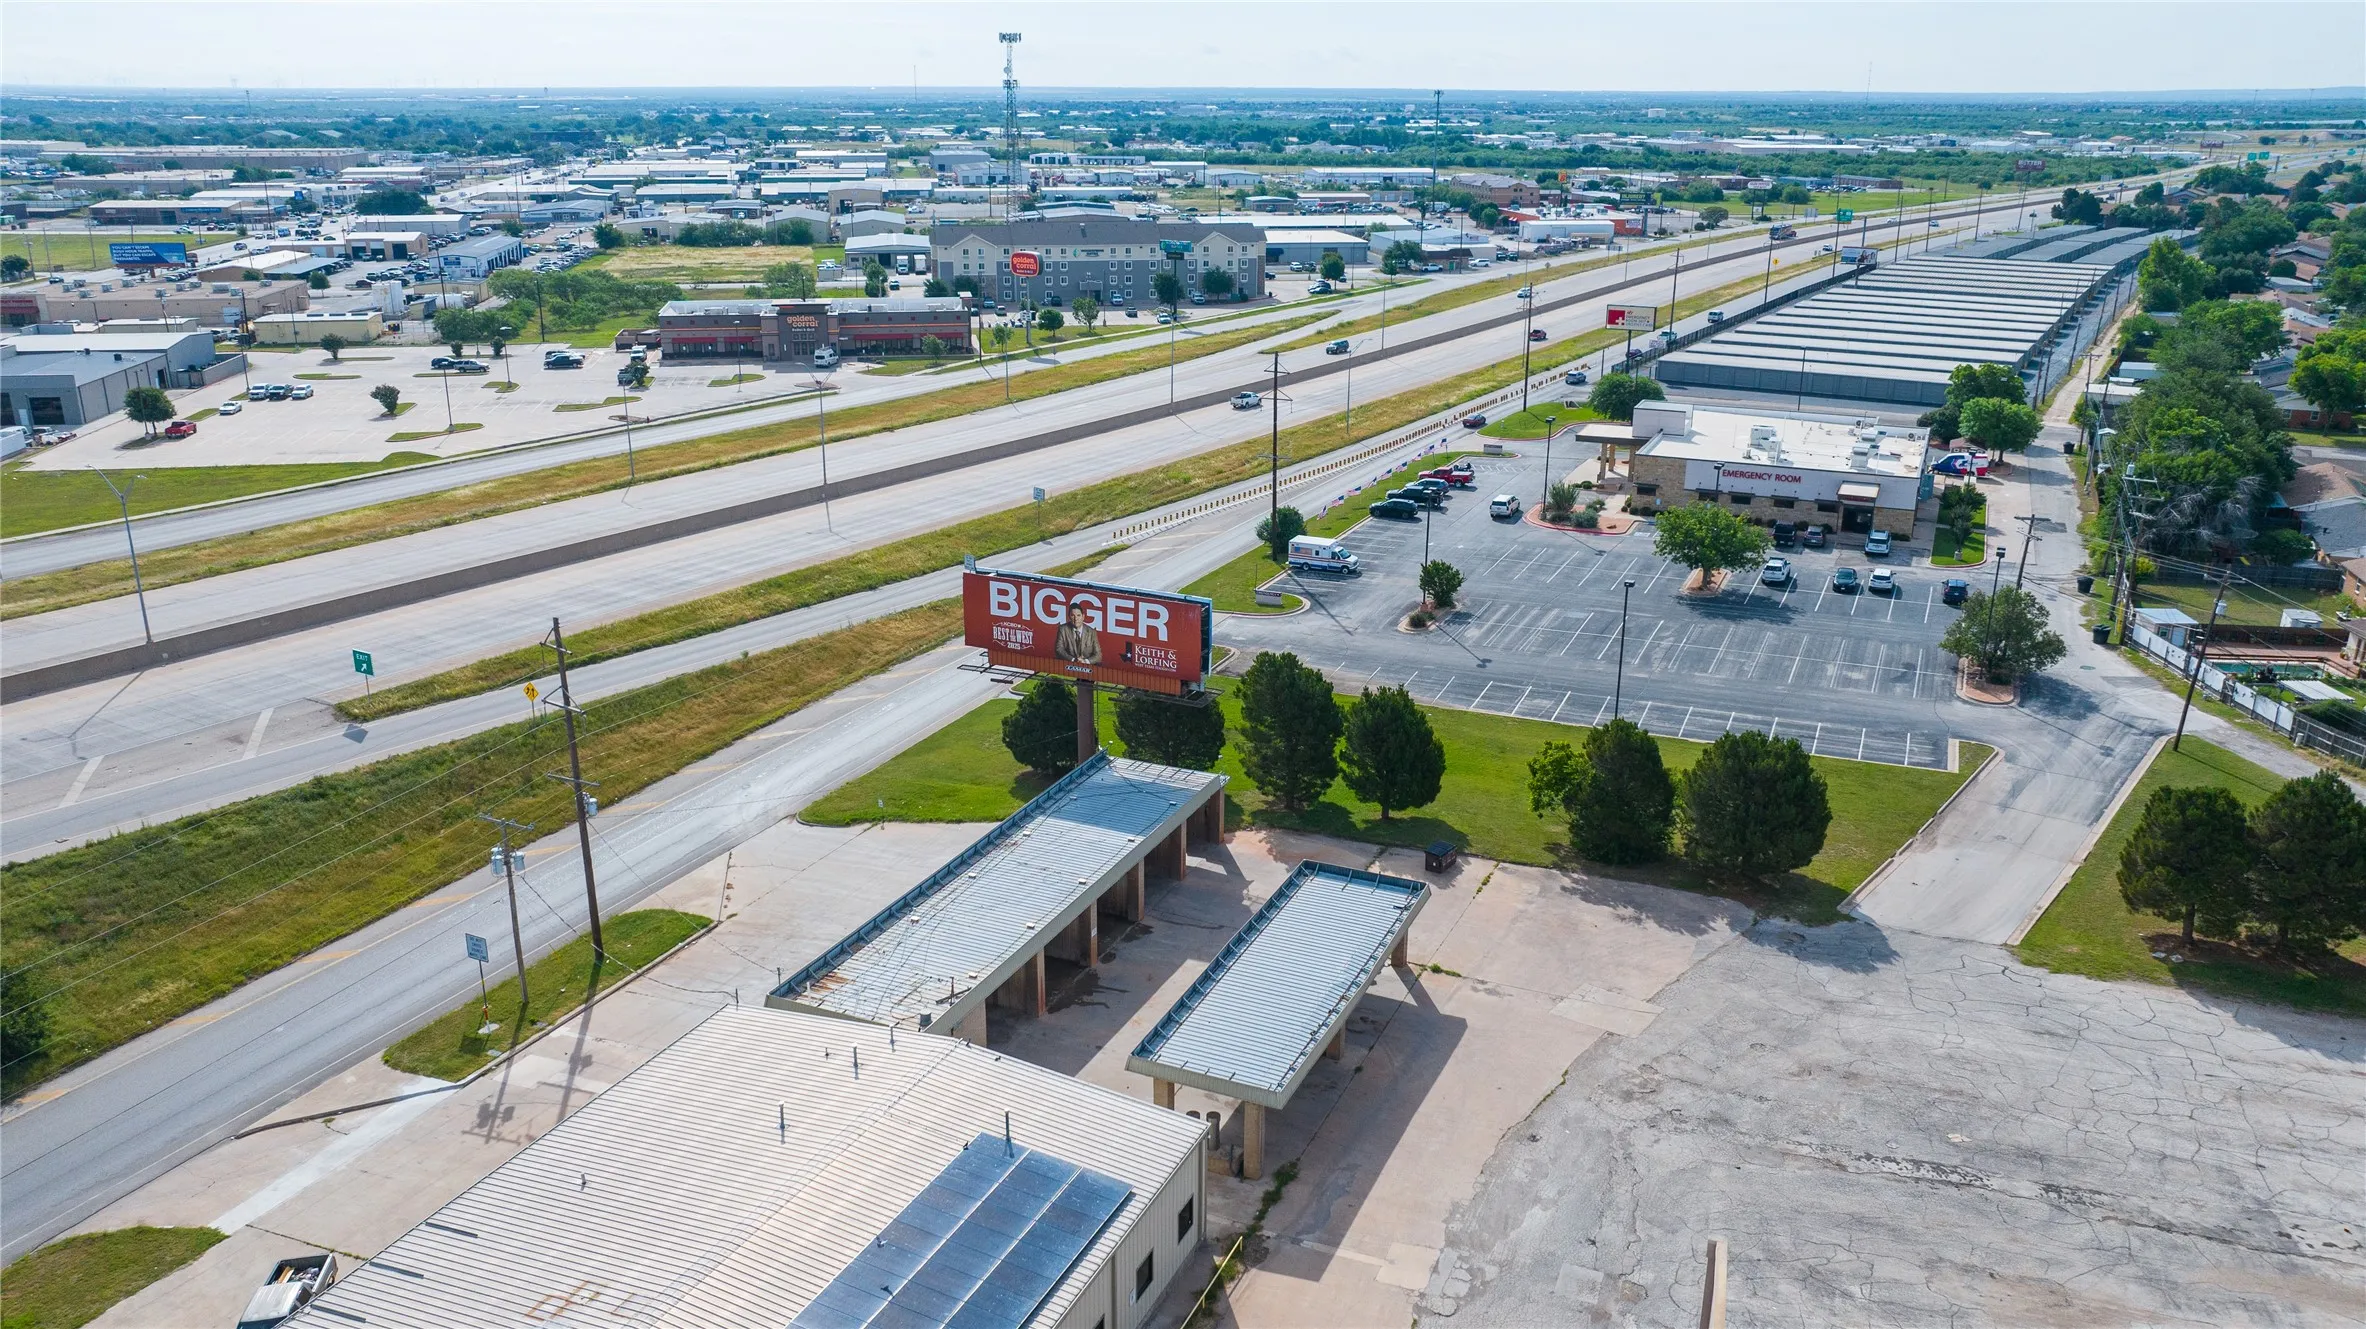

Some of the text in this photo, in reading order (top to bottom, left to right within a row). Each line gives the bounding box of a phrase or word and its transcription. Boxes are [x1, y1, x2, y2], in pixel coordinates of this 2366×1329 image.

[1012, 256, 1034, 265] golden
[786, 314, 815, 324] golden
[1722, 469, 1802, 483] EMERGENCY ROOM
[989, 580, 1170, 642] BIGGER
[992, 626, 1009, 641] BEST
[1016, 629, 1033, 645] WEST
[1007, 641, 1021, 650] 2025
[1135, 645, 1177, 660] KEITH &
[356, 653, 368, 661] EXIT
[1135, 654, 1177, 669] LORFING
